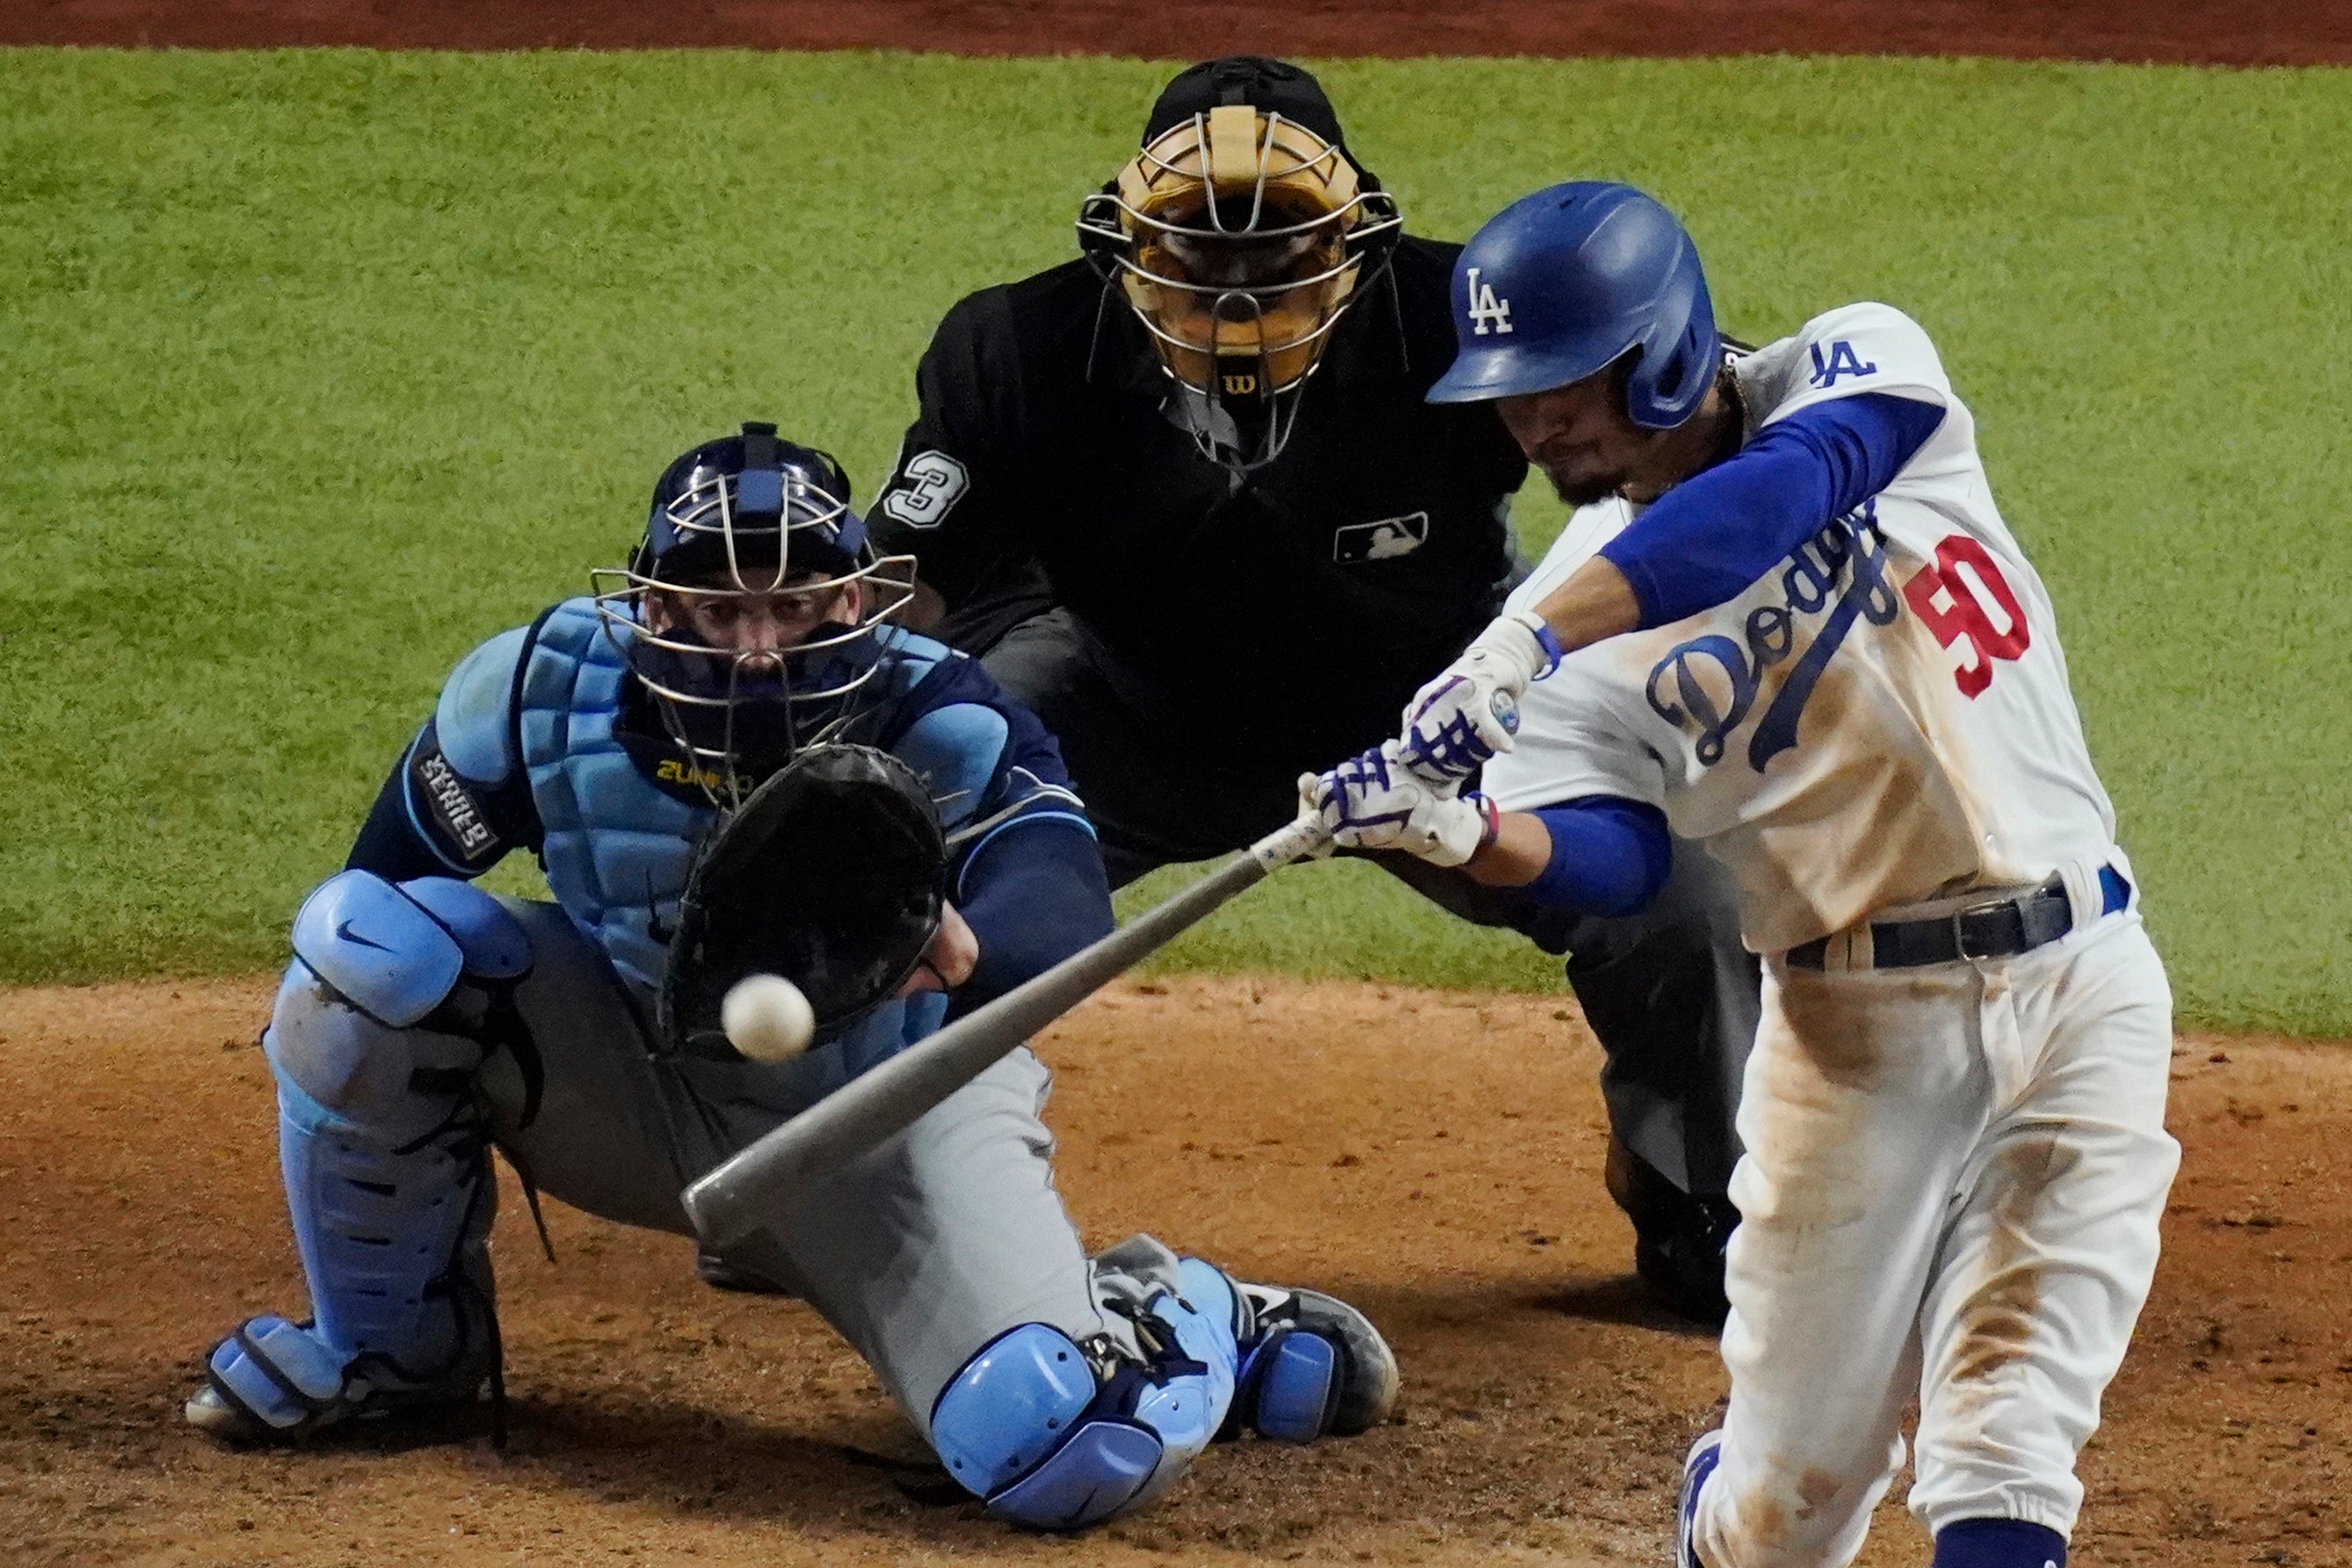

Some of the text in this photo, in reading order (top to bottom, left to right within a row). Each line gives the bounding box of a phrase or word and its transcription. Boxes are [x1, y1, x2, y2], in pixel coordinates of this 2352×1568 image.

[1467, 268, 1513, 335] LA
[883, 449, 970, 528] 3
[1902, 534, 2030, 701] 50
[419, 759, 475, 848] SERIES
